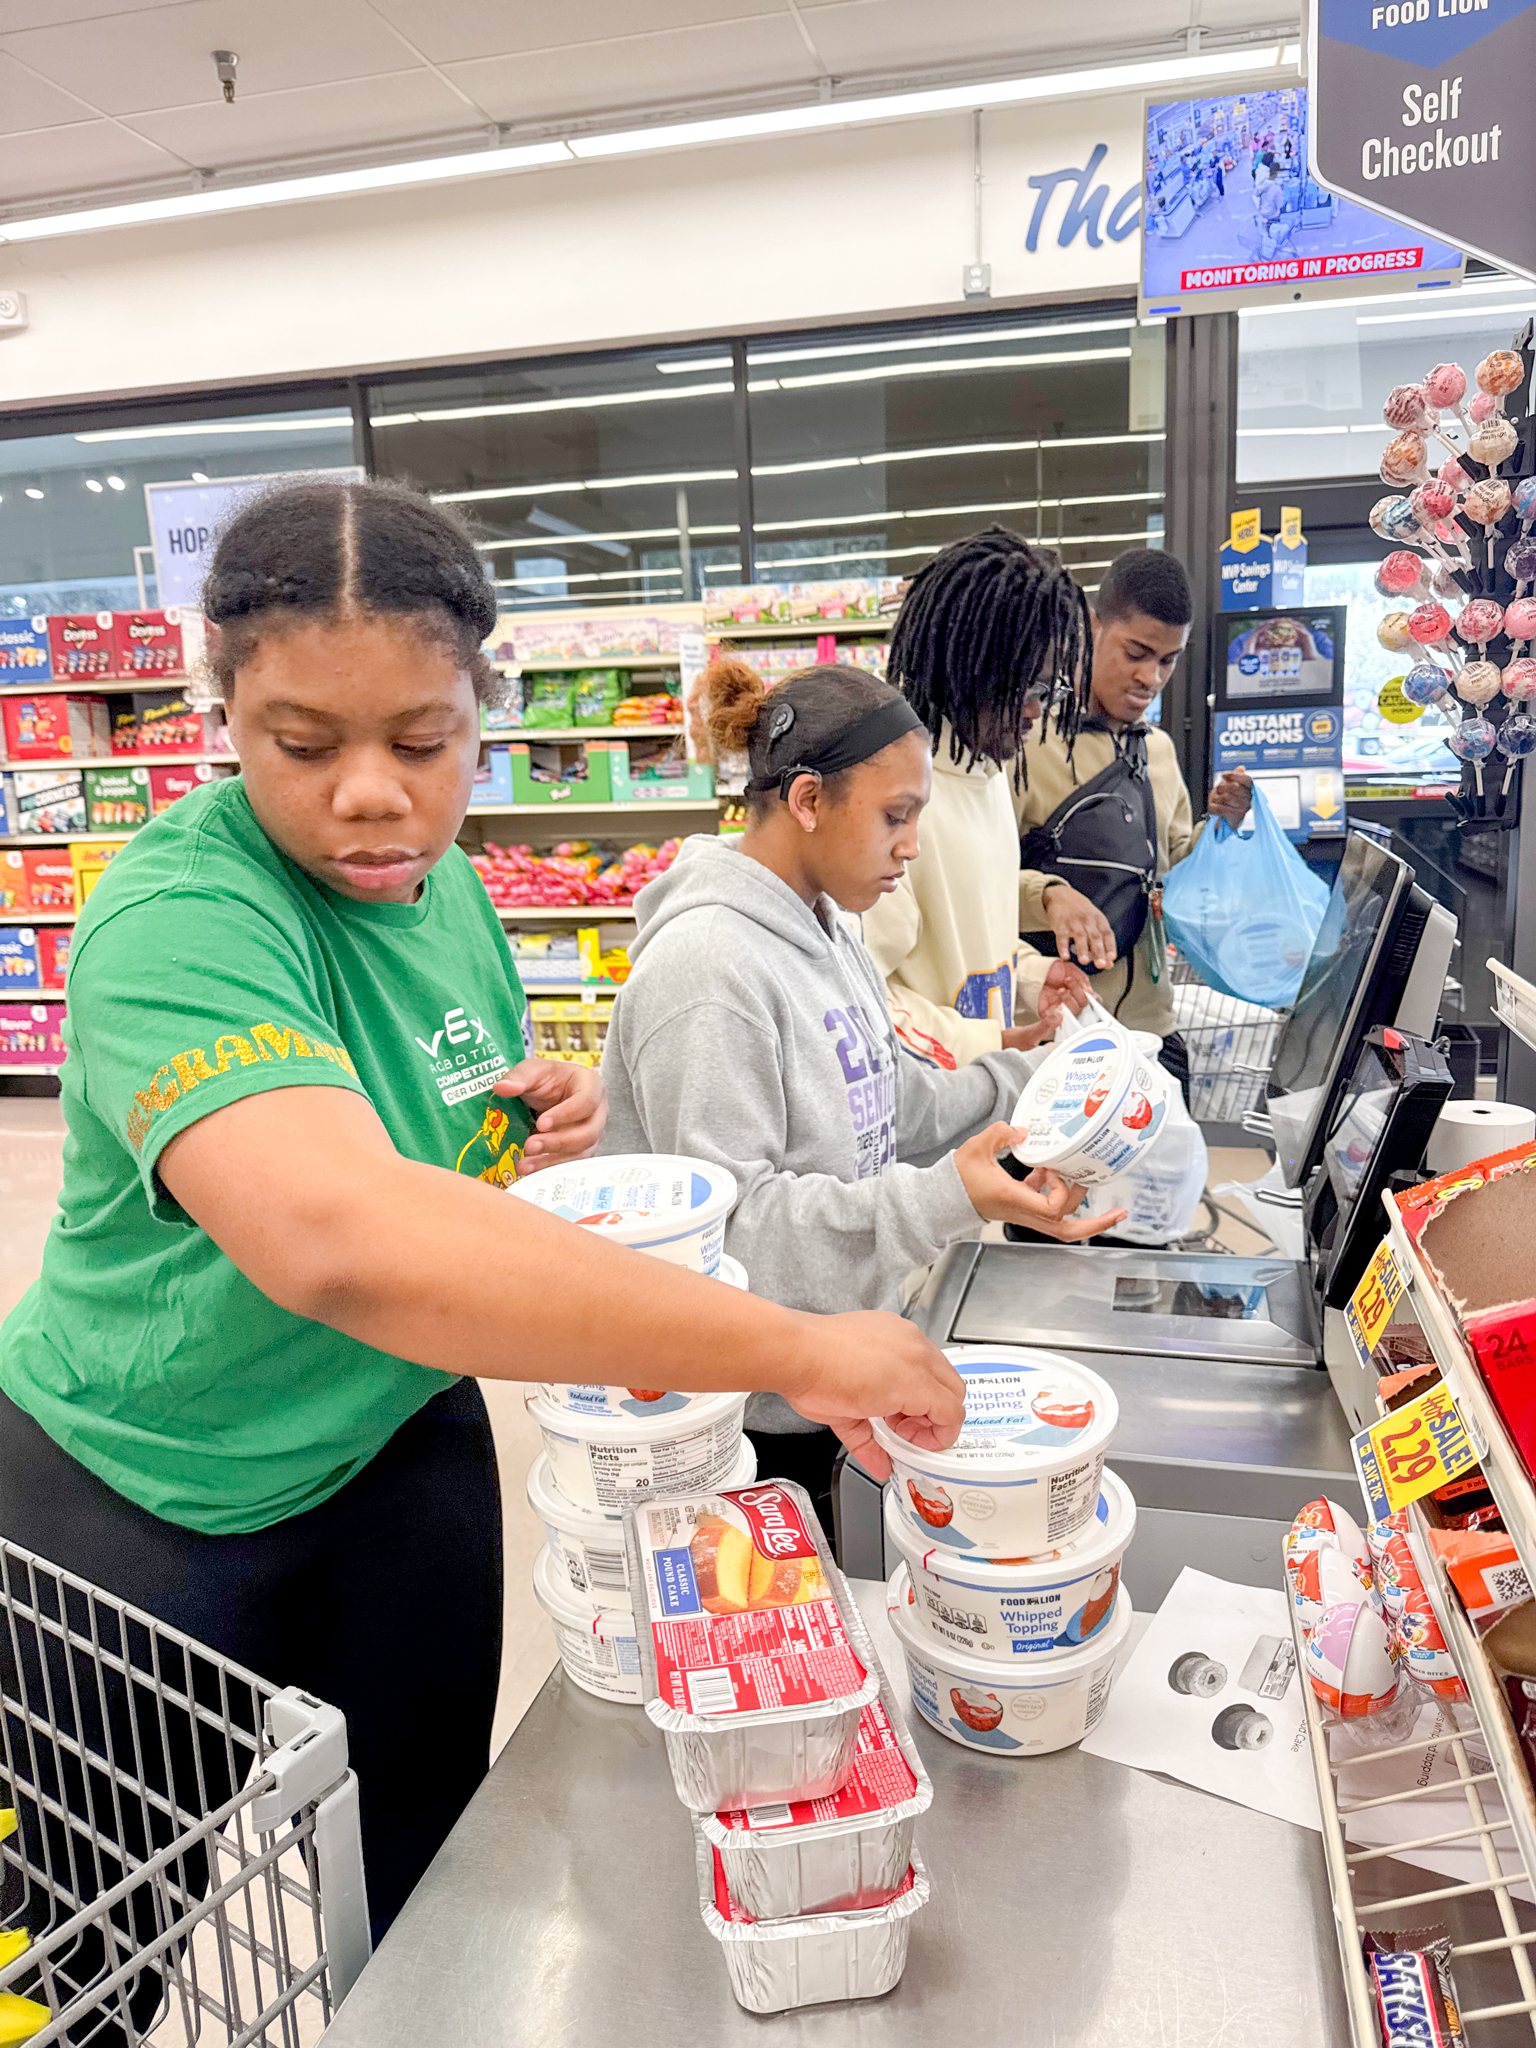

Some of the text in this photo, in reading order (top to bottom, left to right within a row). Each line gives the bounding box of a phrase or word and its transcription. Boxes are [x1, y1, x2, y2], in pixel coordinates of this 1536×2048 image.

[1371, 0, 1428, 30] FOOD
[1401, 77, 1463, 127] Self
[1361, 125, 1501, 181] Checkout
[1185, 250, 1417, 288] MONITORING IN PROGRESS
[1221, 561, 1271, 579] MVP Savings
[1233, 579, 1259, 594] Center
[1227, 713, 1305, 731] INSTANT
[1219, 728, 1305, 746] COUPONS
[1065, 1070, 1099, 1083] Whipped
[1063, 1082, 1091, 1093] Topping
[1089, 1132, 1120, 1160] Whipped
[1098, 1138, 1125, 1163] Topping
[623, 1184, 643, 1208] Topping
[644, 1182, 660, 1209] Whipped
[1372, 1247, 1403, 1308] Hot SALE!
[1359, 1274, 1385, 1330] 2.29
[1486, 1329, 1529, 1359] 24
[1495, 1353, 1534, 1371] BARS
[571, 1382, 606, 1391] pping
[967, 1388, 1026, 1401] hipped
[569, 1391, 606, 1404] Reduced Fat
[963, 1401, 1023, 1411] opping
[1420, 1392, 1446, 1423] Hot
[964, 1417, 1004, 1425] educed
[589, 1444, 637, 1454] Nutrition
[1381, 1417, 1437, 1484] 2.29
[1429, 1410, 1474, 1476] SALE!
[591, 1452, 619, 1461] Facts
[635, 1478, 650, 1487] 20
[1051, 1462, 1089, 1485] Nutrition
[1363, 1458, 1385, 1502] SAVE 70¢
[1051, 1478, 1076, 1492] Facts
[738, 1491, 800, 1555] Sara Lee
[662, 1556, 680, 1607] POUND CAKE
[676, 1563, 690, 1596] CLASSIC
[649, 1584, 657, 1609] DELICIOUS
[1001, 1593, 1061, 1606] FOOD LION
[821, 1601, 846, 1647] Nutrition Facts
[1000, 1607, 1062, 1627] Whipped
[781, 1608, 807, 1653] Calories 340
[1005, 1621, 1059, 1636] Topping
[1015, 1639, 1050, 1653] Original
[670, 1671, 682, 1679] NET
[671, 1679, 683, 1687] WT
[879, 1729, 895, 1748] Facts
[1290, 1733, 1306, 1753] Cake
[1417, 1751, 1436, 1787] topping
